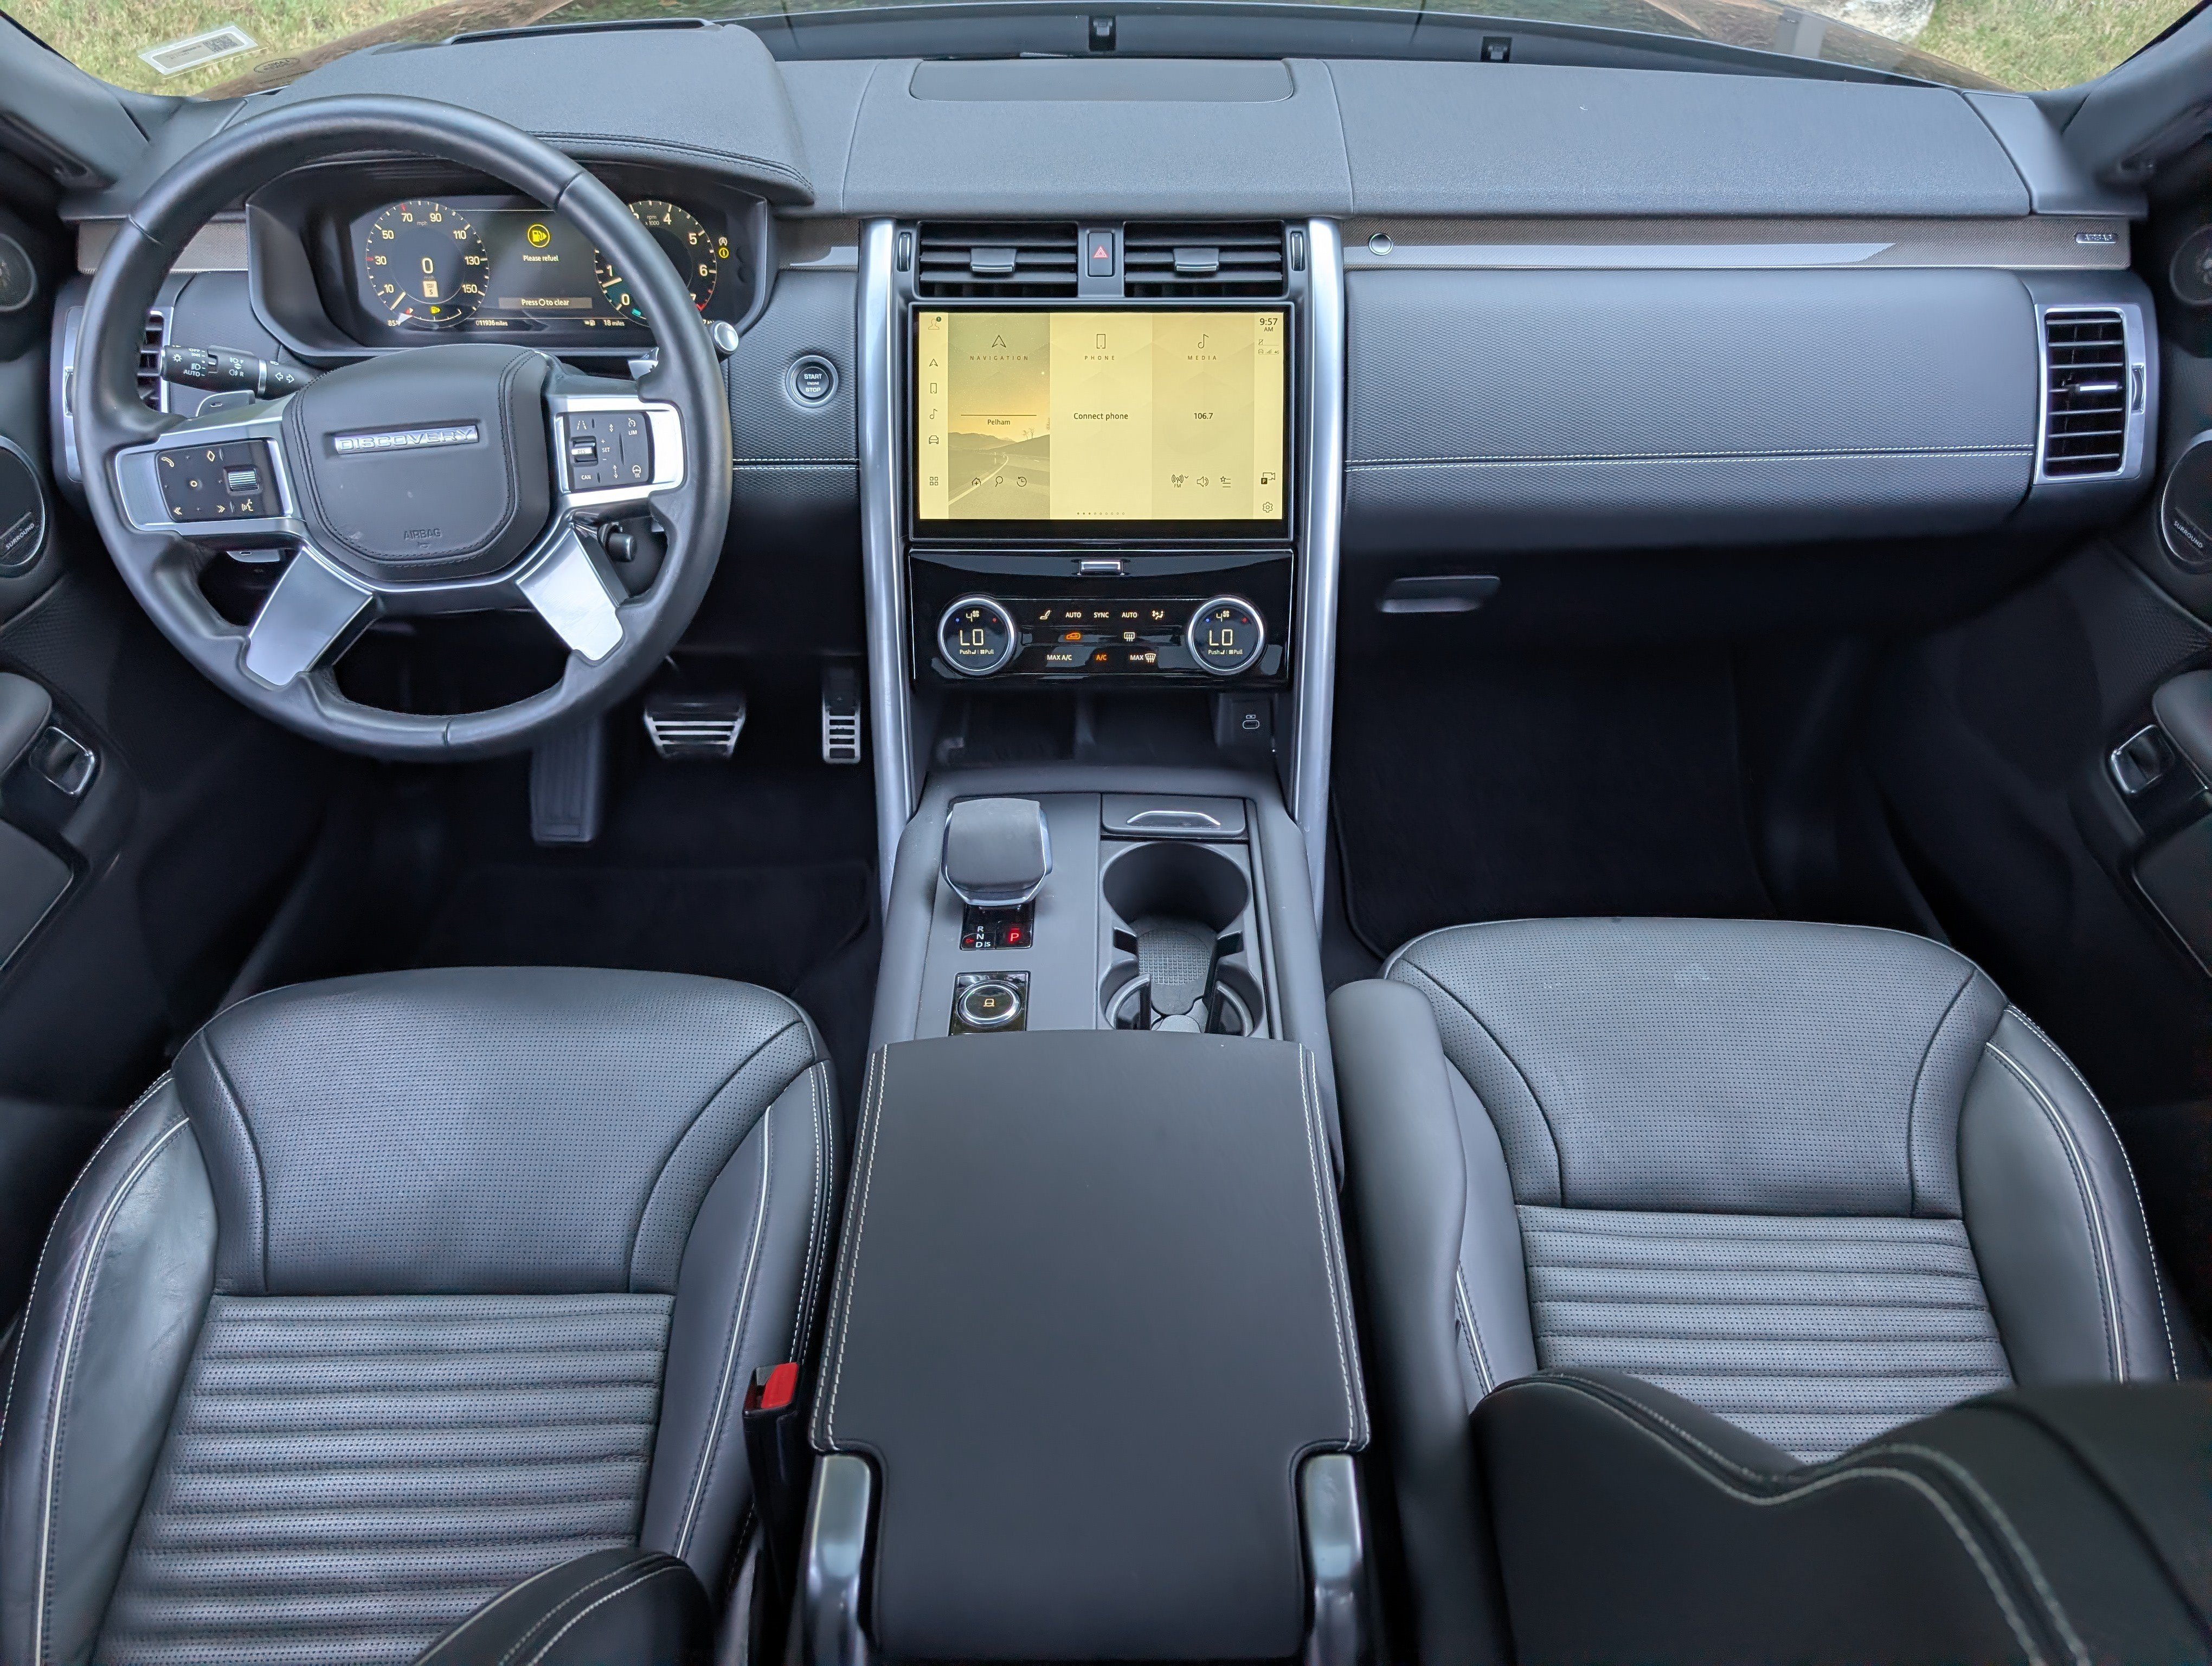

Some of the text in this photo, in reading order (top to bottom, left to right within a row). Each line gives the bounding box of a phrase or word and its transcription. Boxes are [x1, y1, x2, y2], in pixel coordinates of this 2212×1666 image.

[401, 213, 413, 222] 70
[429, 213, 442, 222] 90
[663, 213, 672, 225] 4
[382, 230, 394, 240] 50
[453, 230, 467, 240] 110
[688, 233, 697, 245] 5
[375, 256, 387, 265] 30
[422, 258, 433, 274] 0
[465, 256, 480, 265] 130
[606, 264, 613, 277] 1
[699, 264, 708, 277] 6
[384, 284, 394, 293] 10
[462, 284, 478, 293] 150
[621, 293, 630, 306] 0
[1105, 412, 1128, 421] phone
[339, 428, 473, 451] DISCOVERY
[5, 522, 35, 550] SURROUND
[403, 528, 442, 541] AIRBAG
[2174, 520, 2204, 549] SURROUND
[966, 613, 973, 622] 4
[1216, 613, 1223, 622] 4
[960, 629, 984, 646] LO
[1209, 629, 1233, 646] LO
[1011, 933, 1019, 941] P
